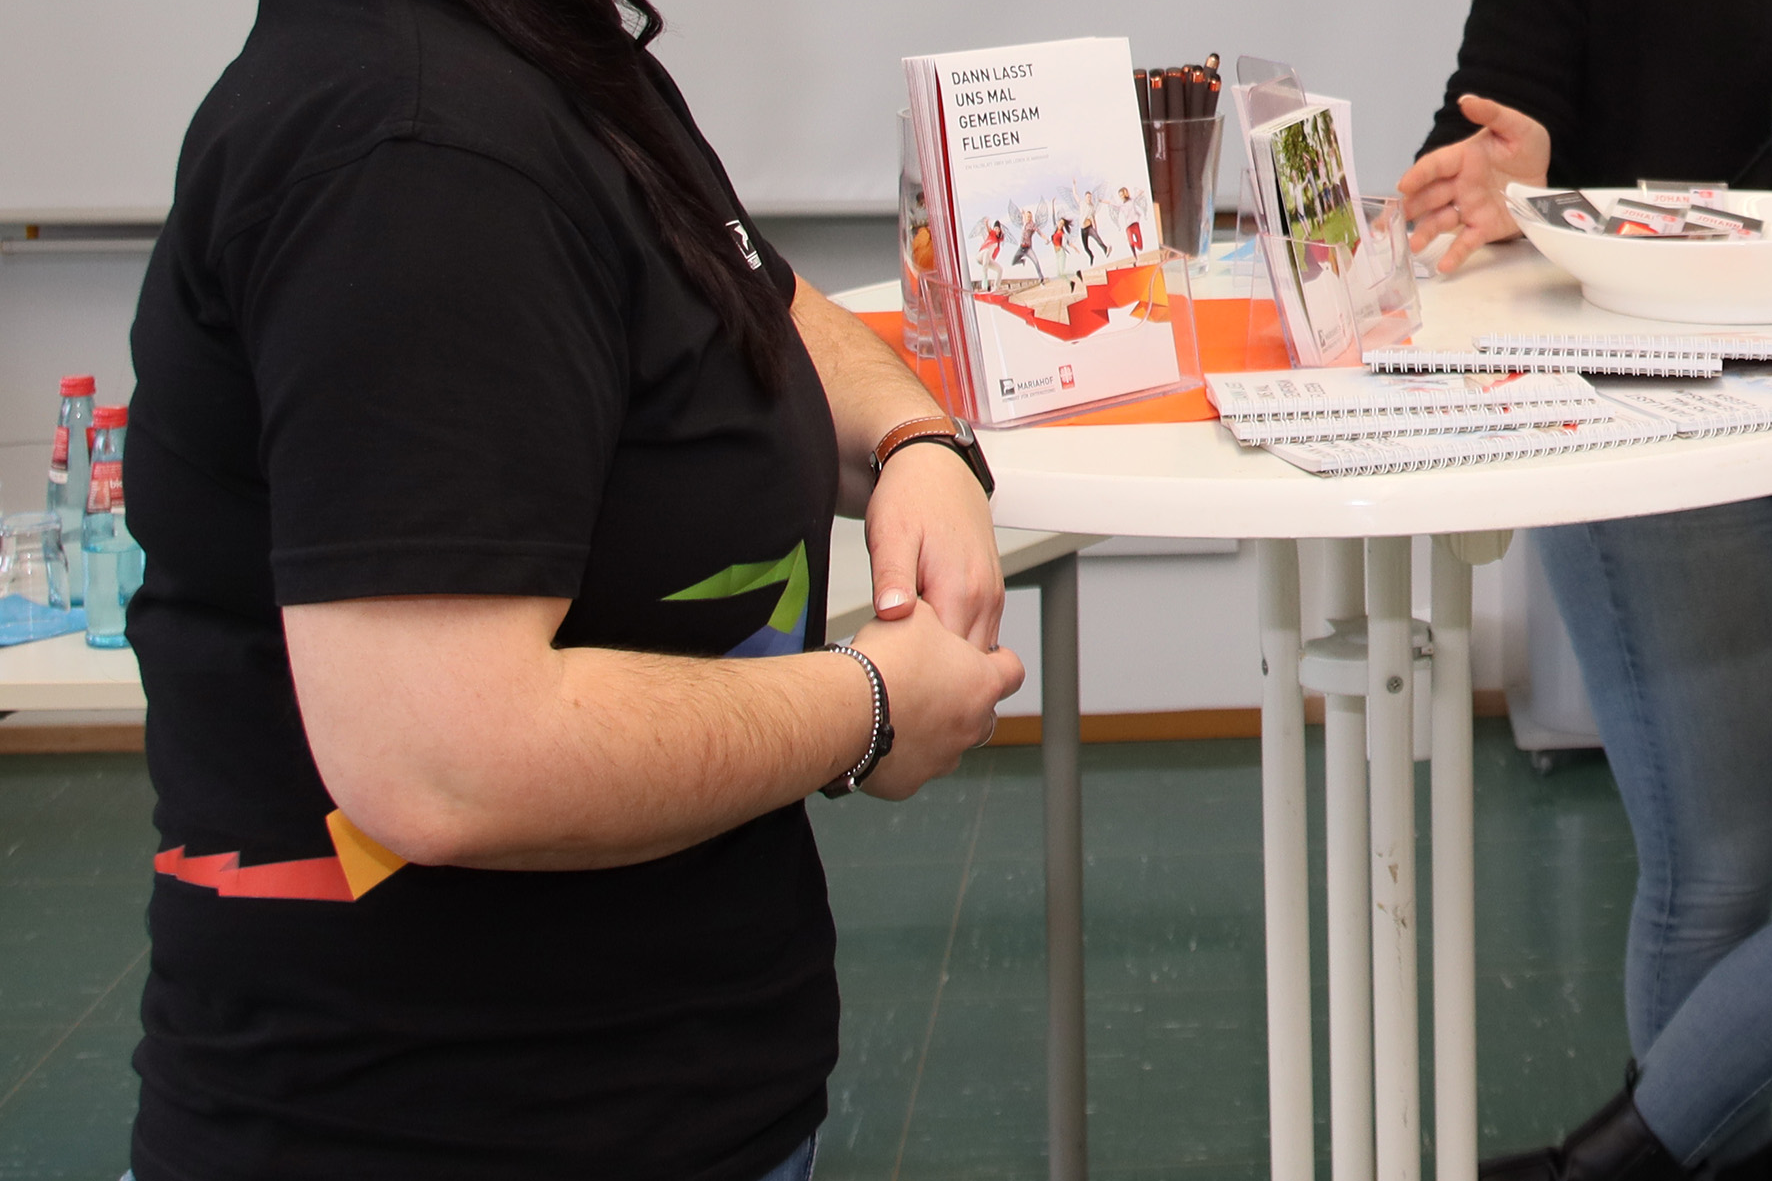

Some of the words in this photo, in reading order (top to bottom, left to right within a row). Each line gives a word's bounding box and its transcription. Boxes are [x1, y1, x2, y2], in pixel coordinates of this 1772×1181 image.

[951, 68, 991, 86] DANN
[993, 63, 1034, 81] LASST
[955, 90, 984, 107] UNS
[987, 87, 1017, 103] MAL
[958, 106, 1041, 130] GEMEINSAM
[962, 130, 1021, 151] FLIEGEN
[1017, 376, 1054, 391] MARIAHOF
